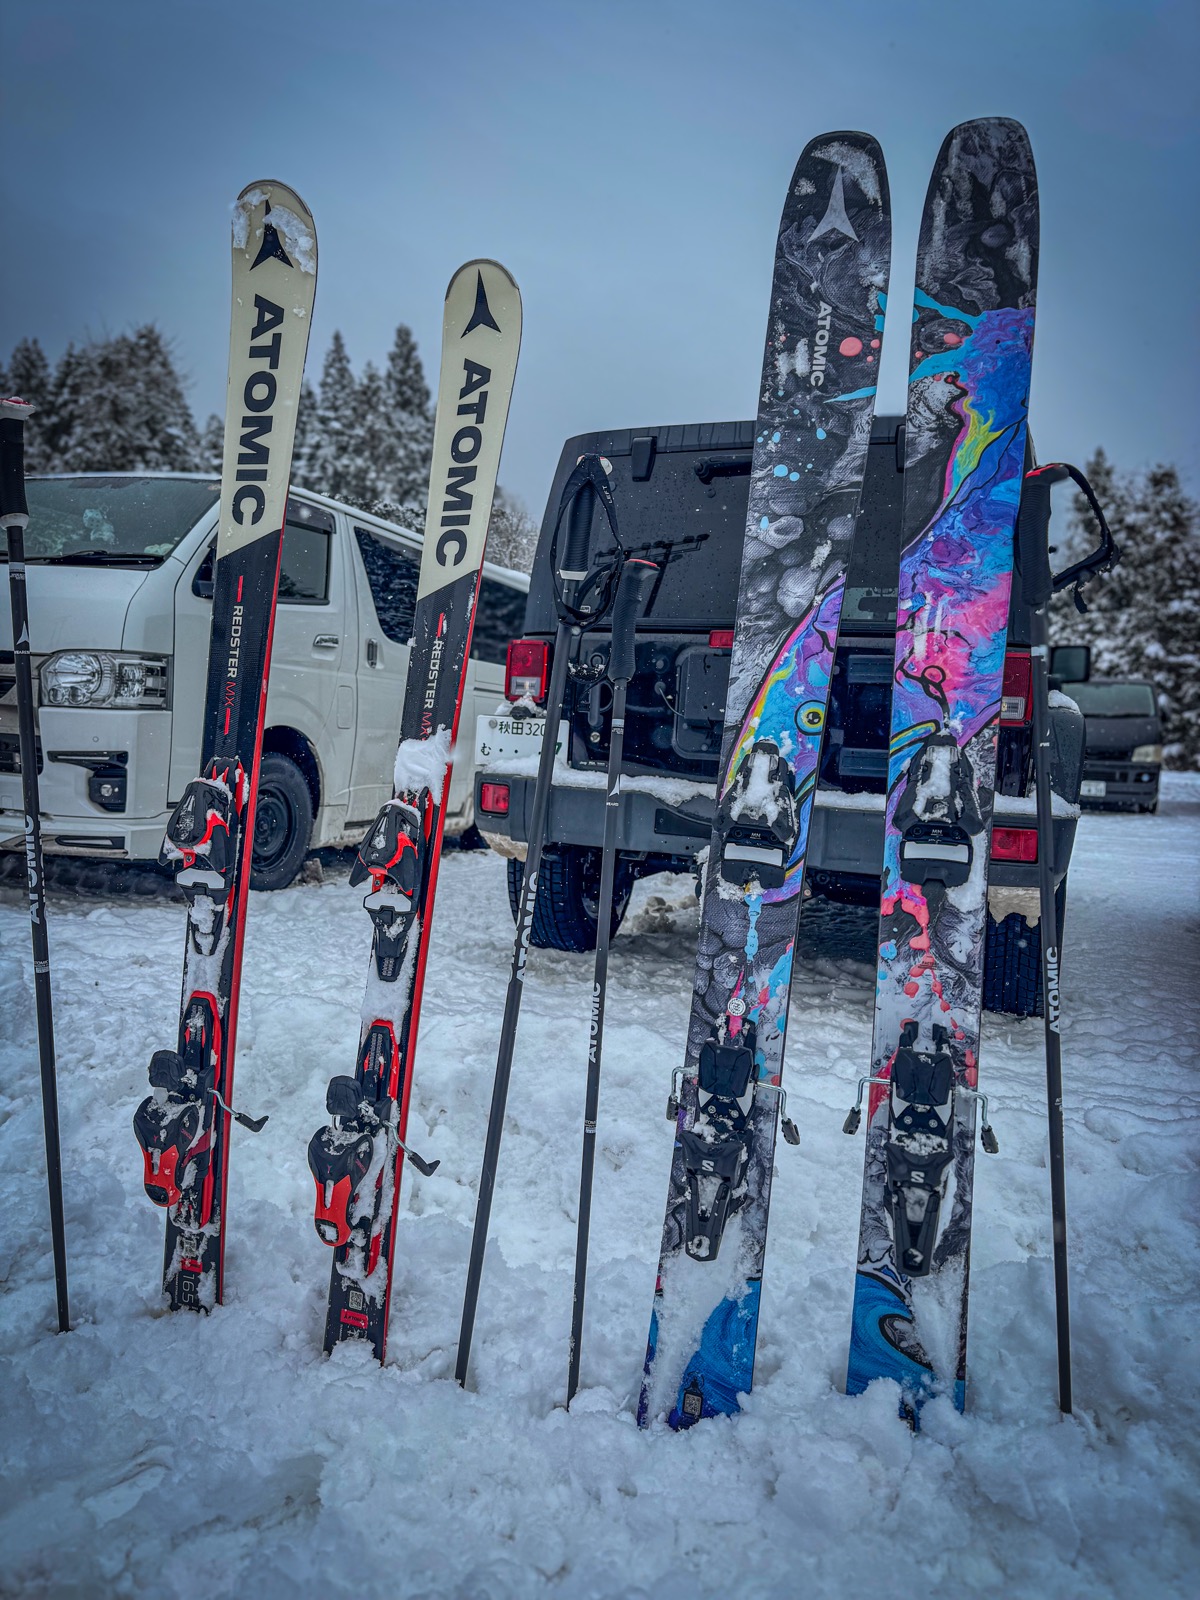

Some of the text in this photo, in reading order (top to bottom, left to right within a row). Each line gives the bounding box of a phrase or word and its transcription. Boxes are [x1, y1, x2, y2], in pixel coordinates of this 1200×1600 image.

[811, 300, 832, 387] ATOMIC
[232, 293, 284, 526] ATOMIC
[435, 357, 492, 567] ATOMIC
[224, 605, 243, 706] REDSTER MX
[423, 639, 445, 709] REDSTER
[498, 721, 524, 735] 秋田
[1047, 946, 1061, 1035] ATOMIC
[182, 1273, 195, 1304] 165
